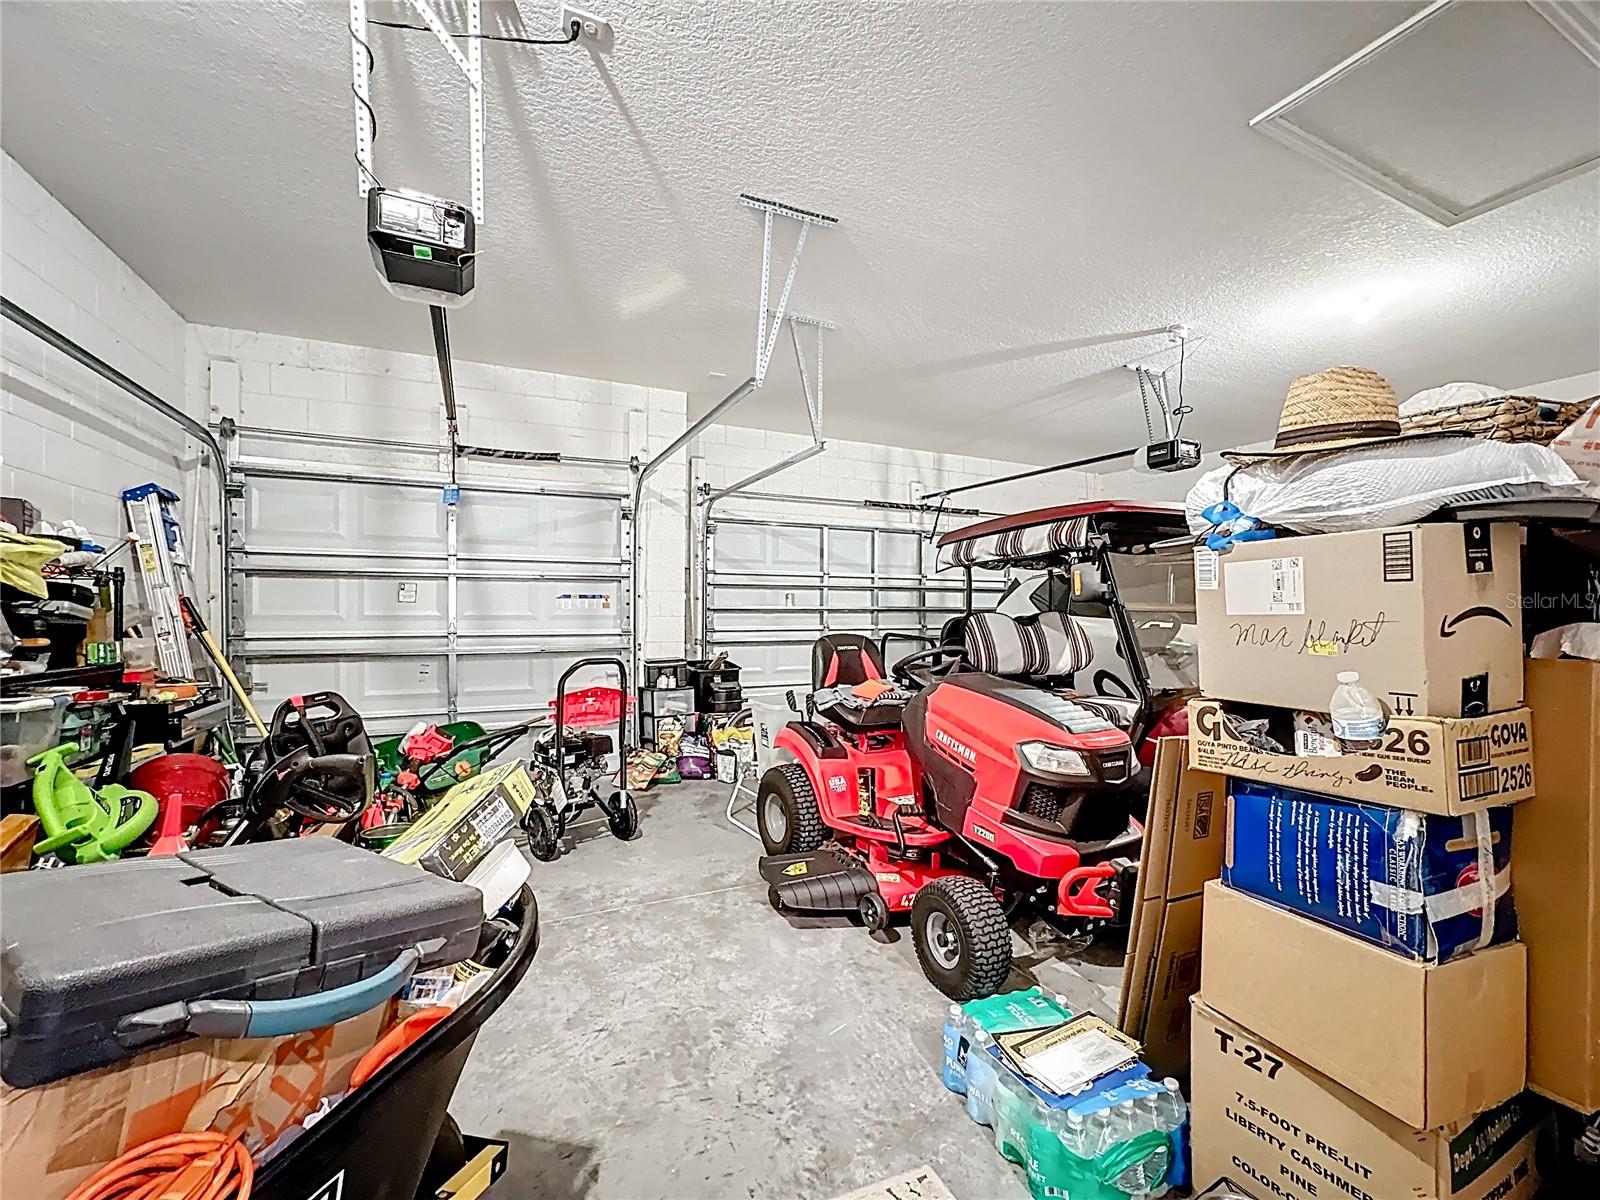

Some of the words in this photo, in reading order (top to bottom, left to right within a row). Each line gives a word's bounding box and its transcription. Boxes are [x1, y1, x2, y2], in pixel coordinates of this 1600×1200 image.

[936, 729, 977, 764] CRAFTSMAN
[1217, 743, 1238, 751] PINTO
[1491, 722, 1528, 748] GOYA
[1385, 768, 1407, 776] THE
[1385, 775, 1415, 784] BEAN
[1501, 763, 1532, 793] 2526
[973, 824, 995, 842] T2200
[1389, 848, 1397, 882] CLASSIC
[1214, 1027, 1284, 1080] T-27
[1235, 1091, 1301, 1137] 7.5-FOOT
[1305, 1133, 1373, 1180] PRE-LIT
[1225, 1107, 1286, 1152] LIBERTY
[1290, 1149, 1375, 1200] CASHMER
[1232, 1156, 1300, 1200] COLOR-C
[1280, 1164, 1318, 1198] PINE
